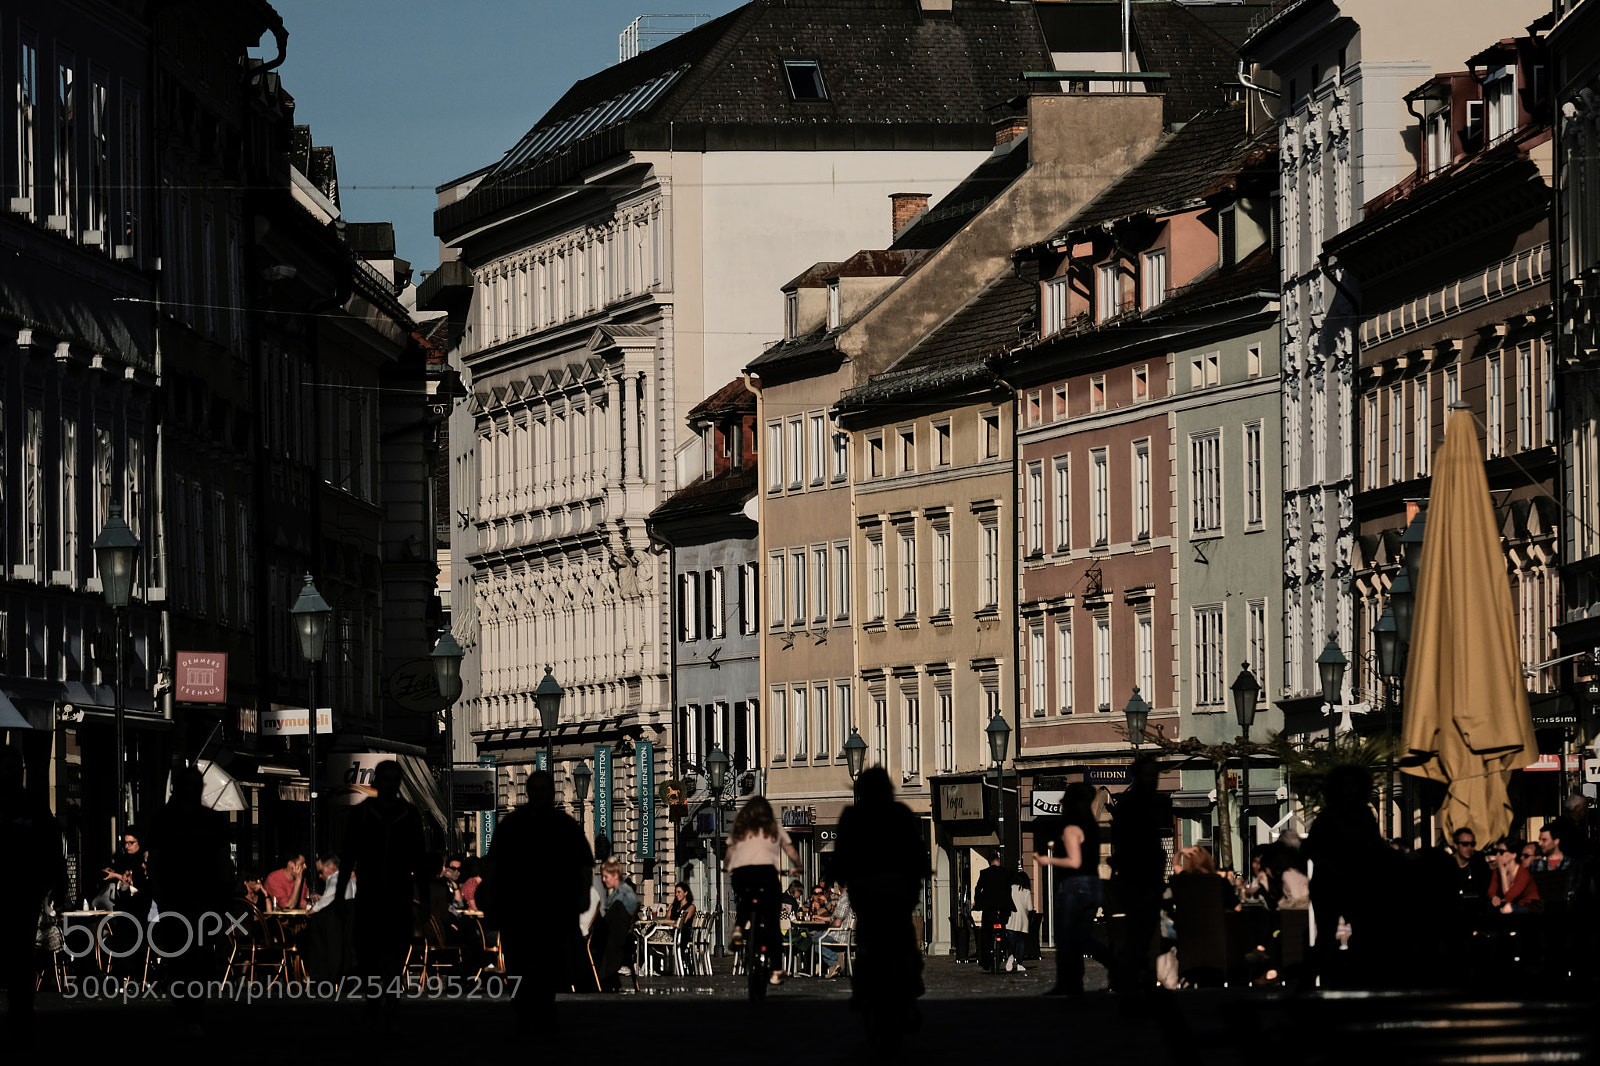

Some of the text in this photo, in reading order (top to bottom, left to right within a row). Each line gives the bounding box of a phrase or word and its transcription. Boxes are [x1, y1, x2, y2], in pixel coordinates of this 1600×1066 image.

[182, 658, 220, 668] DEMMERS
[180, 685, 220, 696] TEEHAUS
[599, 788, 606, 798] OF
[642, 786, 648, 796] OF
[599, 800, 607, 827] COLORS
